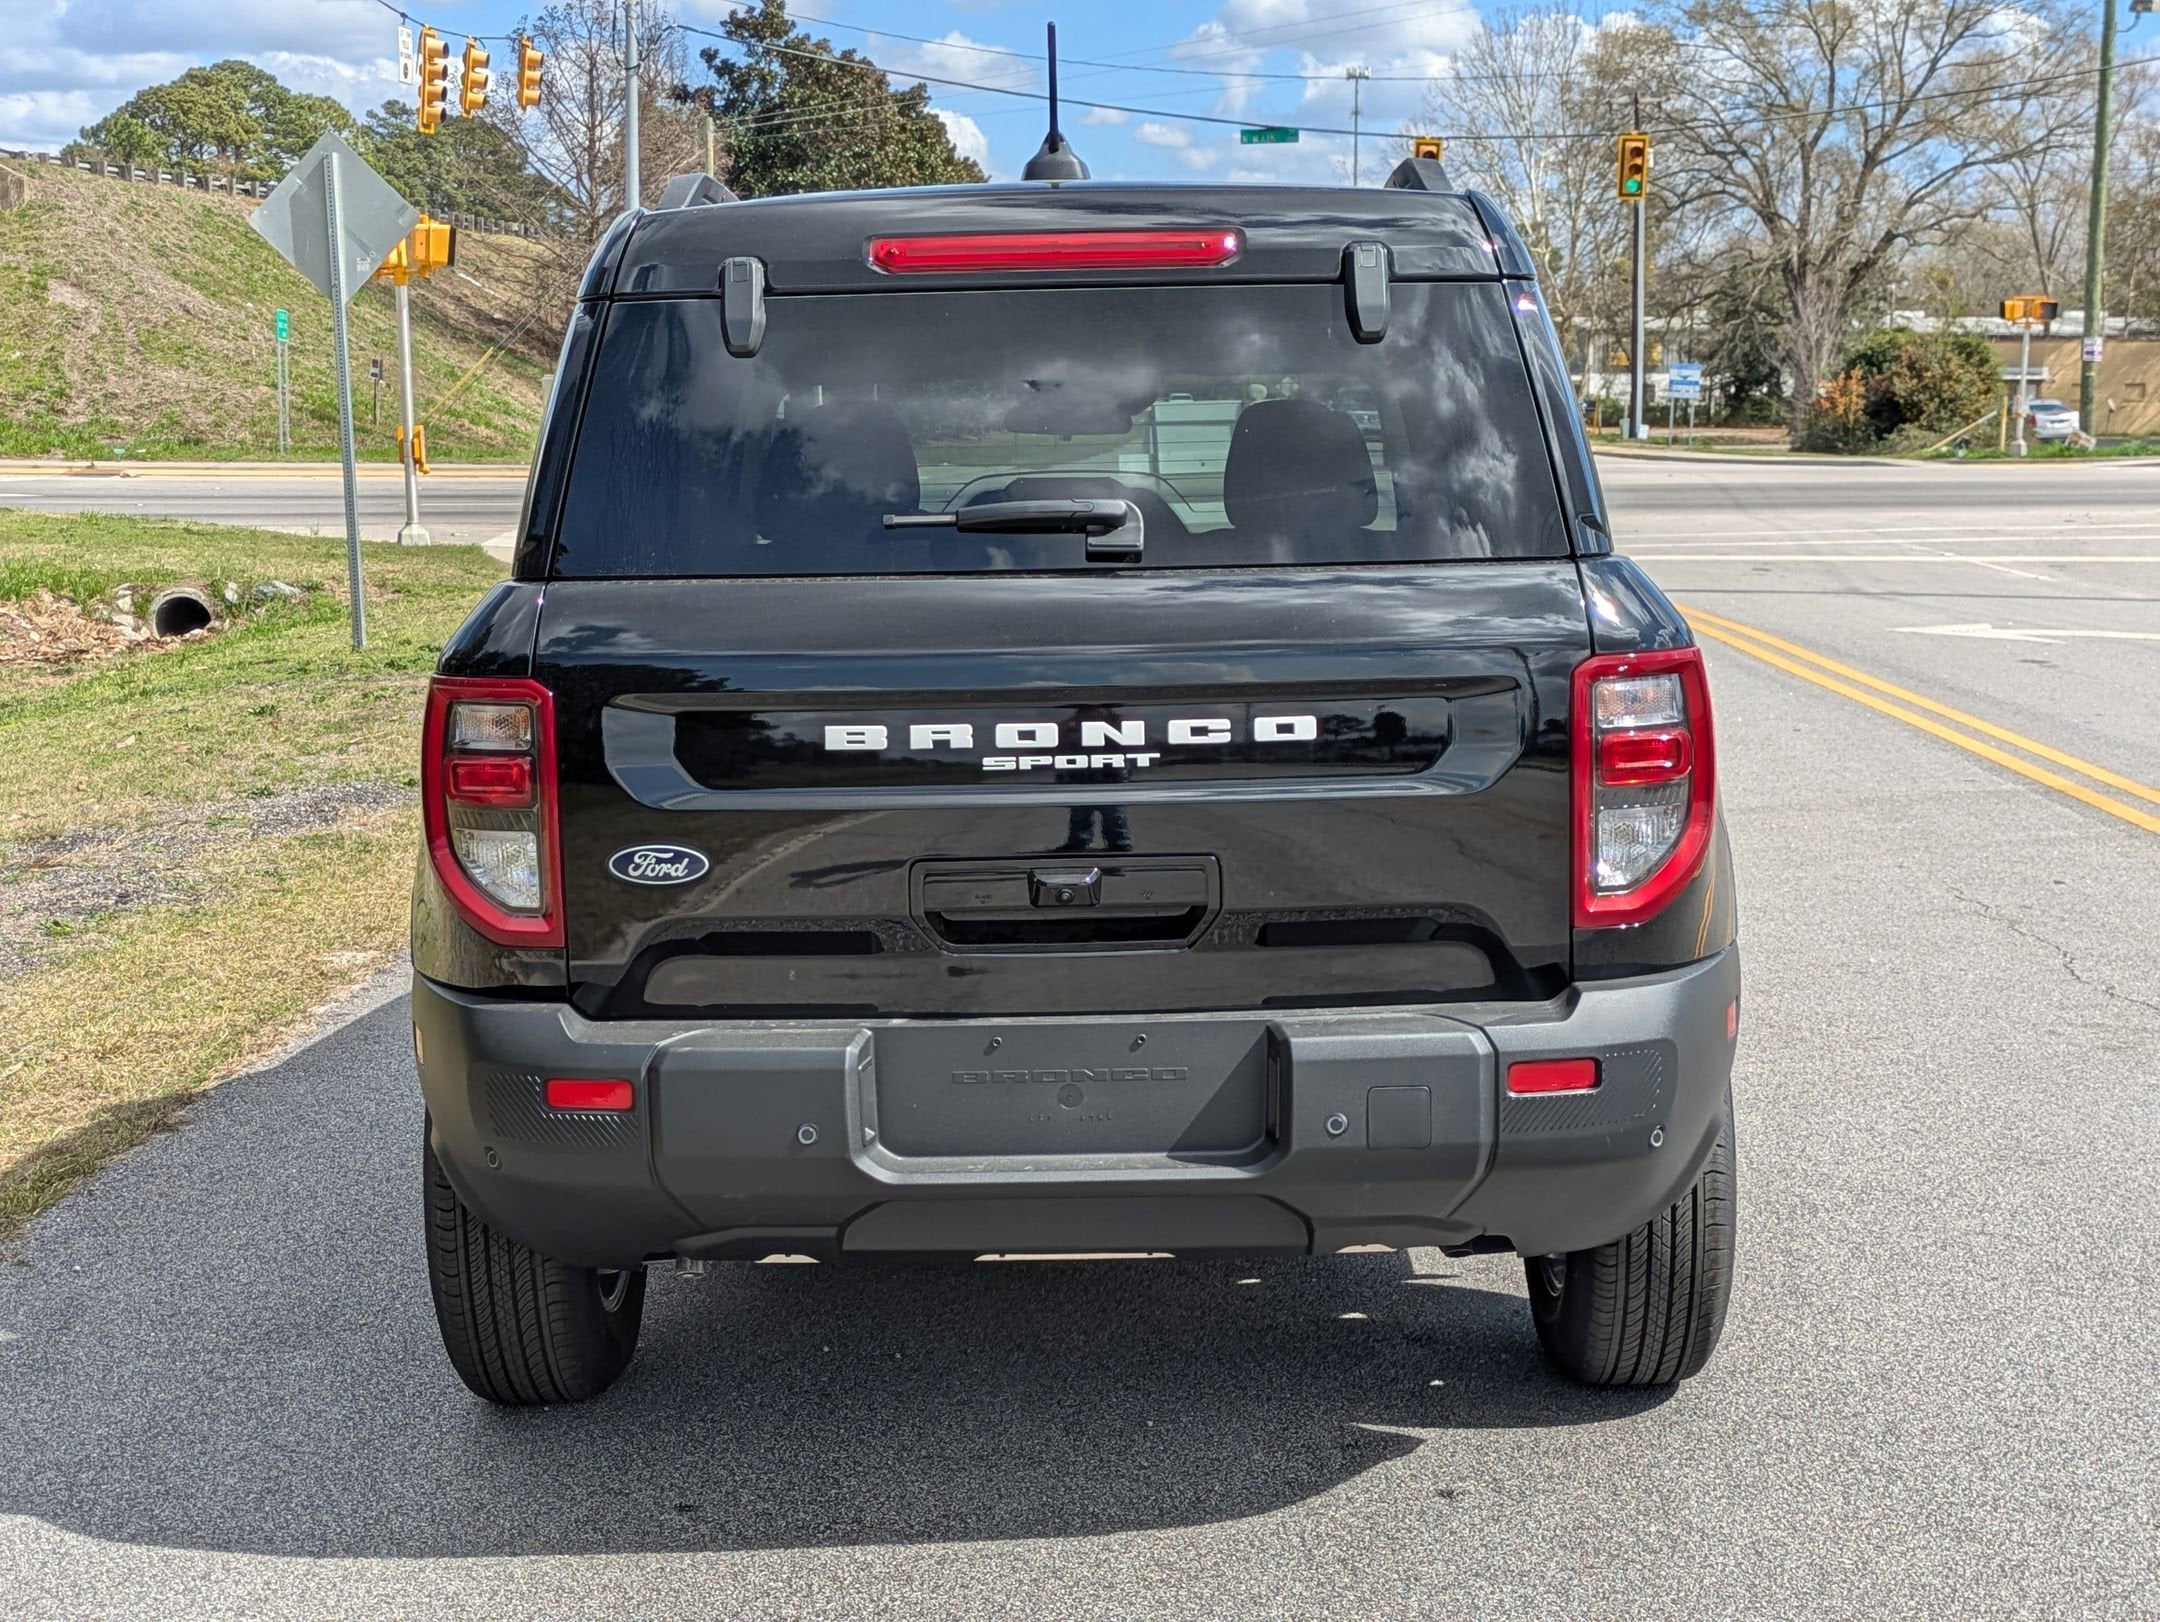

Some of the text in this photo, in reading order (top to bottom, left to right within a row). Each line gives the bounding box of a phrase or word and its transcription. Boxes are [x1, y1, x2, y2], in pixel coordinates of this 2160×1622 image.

[824, 715, 1318, 751] BRONCO
[981, 752, 1161, 772] SPORT
[627, 850, 690, 878] Ford
[951, 1066, 1188, 1084] BRONCO
